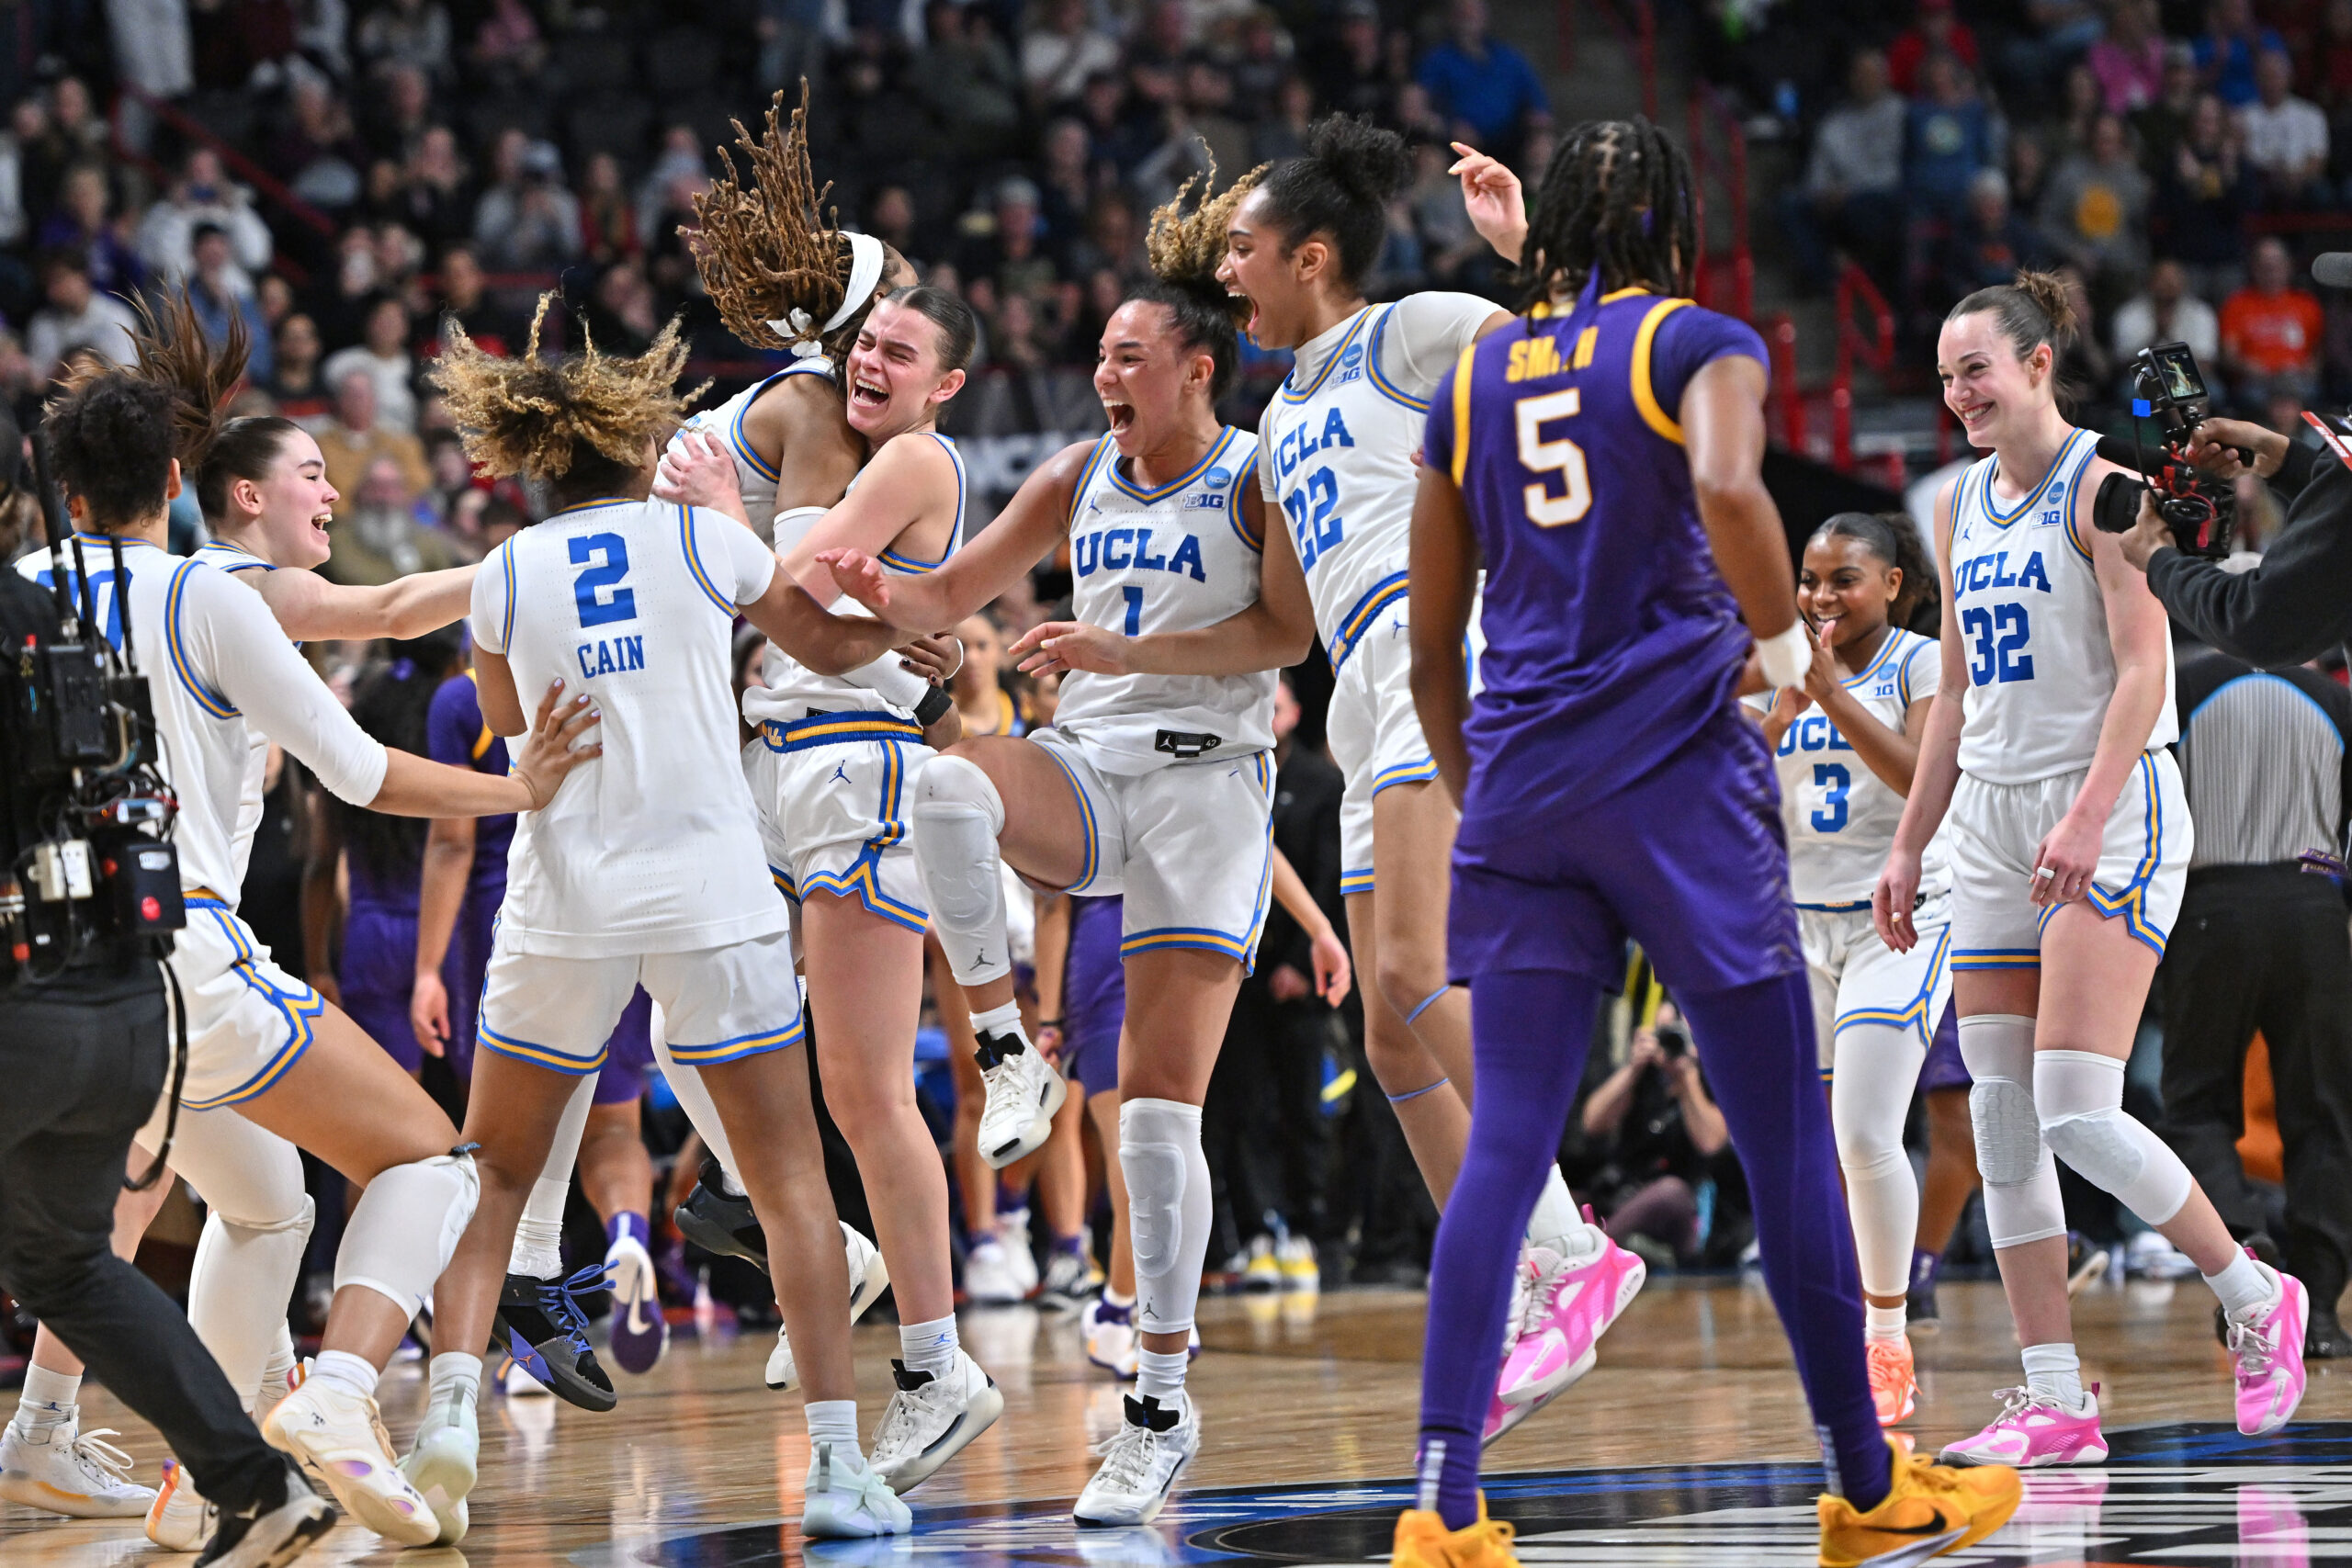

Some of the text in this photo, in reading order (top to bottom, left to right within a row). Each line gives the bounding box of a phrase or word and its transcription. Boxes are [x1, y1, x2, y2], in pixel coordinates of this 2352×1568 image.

[1506, 325, 1600, 383] SMH
[1514, 387, 1593, 528] 5
[1283, 466, 1344, 574] 22
[568, 532, 637, 628] 2
[1076, 528, 1206, 583] UCLA
[1954, 550, 2052, 603] UCLA
[1123, 586, 1144, 637] 1
[577, 635, 645, 679] CAIN
[1962, 602, 2034, 686] 32
[1205, 739, 1217, 747] 42
[1777, 716, 1855, 757] UCL
[1811, 763, 1850, 832] 3
